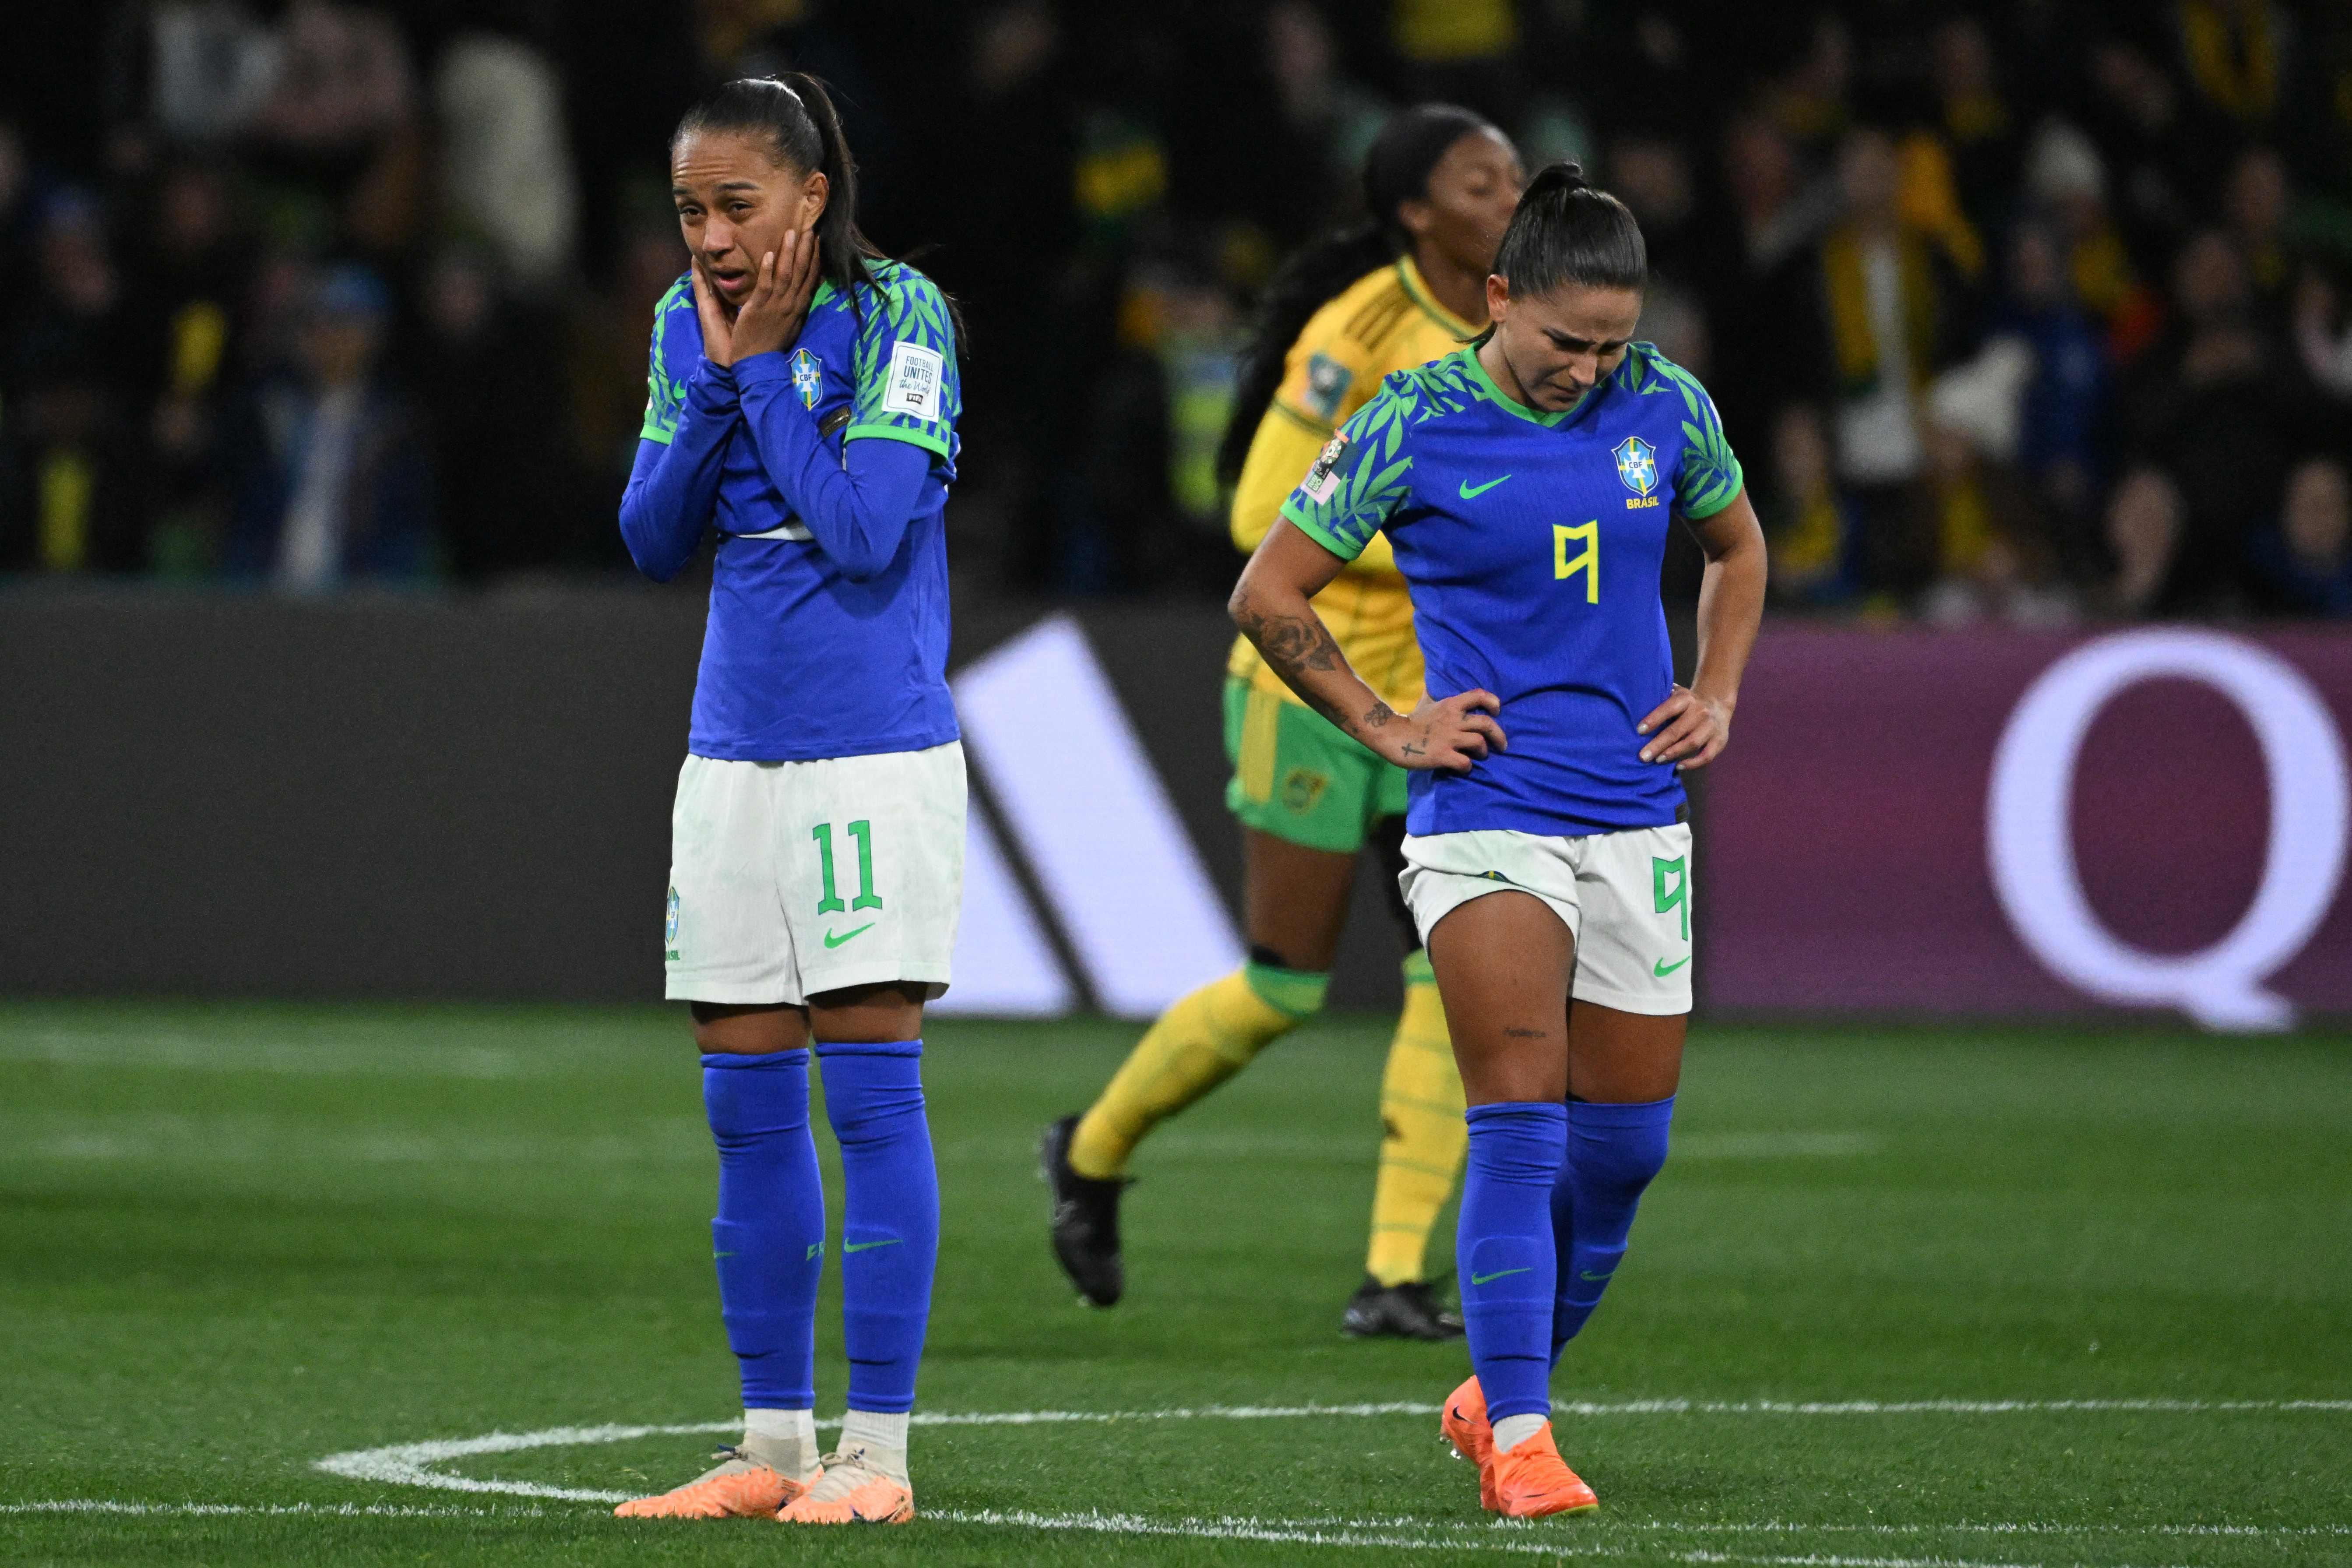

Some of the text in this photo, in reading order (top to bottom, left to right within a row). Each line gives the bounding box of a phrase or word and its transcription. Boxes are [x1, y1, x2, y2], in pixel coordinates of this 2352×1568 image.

[899, 378, 912, 389] the
[903, 365, 932, 384] UNITES
[906, 356, 933, 372] FOOTBALL
[1626, 496, 1659, 509] BRASIL
[1553, 519, 1599, 604] 9
[1985, 627, 2350, 1032] Q
[812, 820, 883, 915] 11
[1652, 854, 1688, 941] 9
